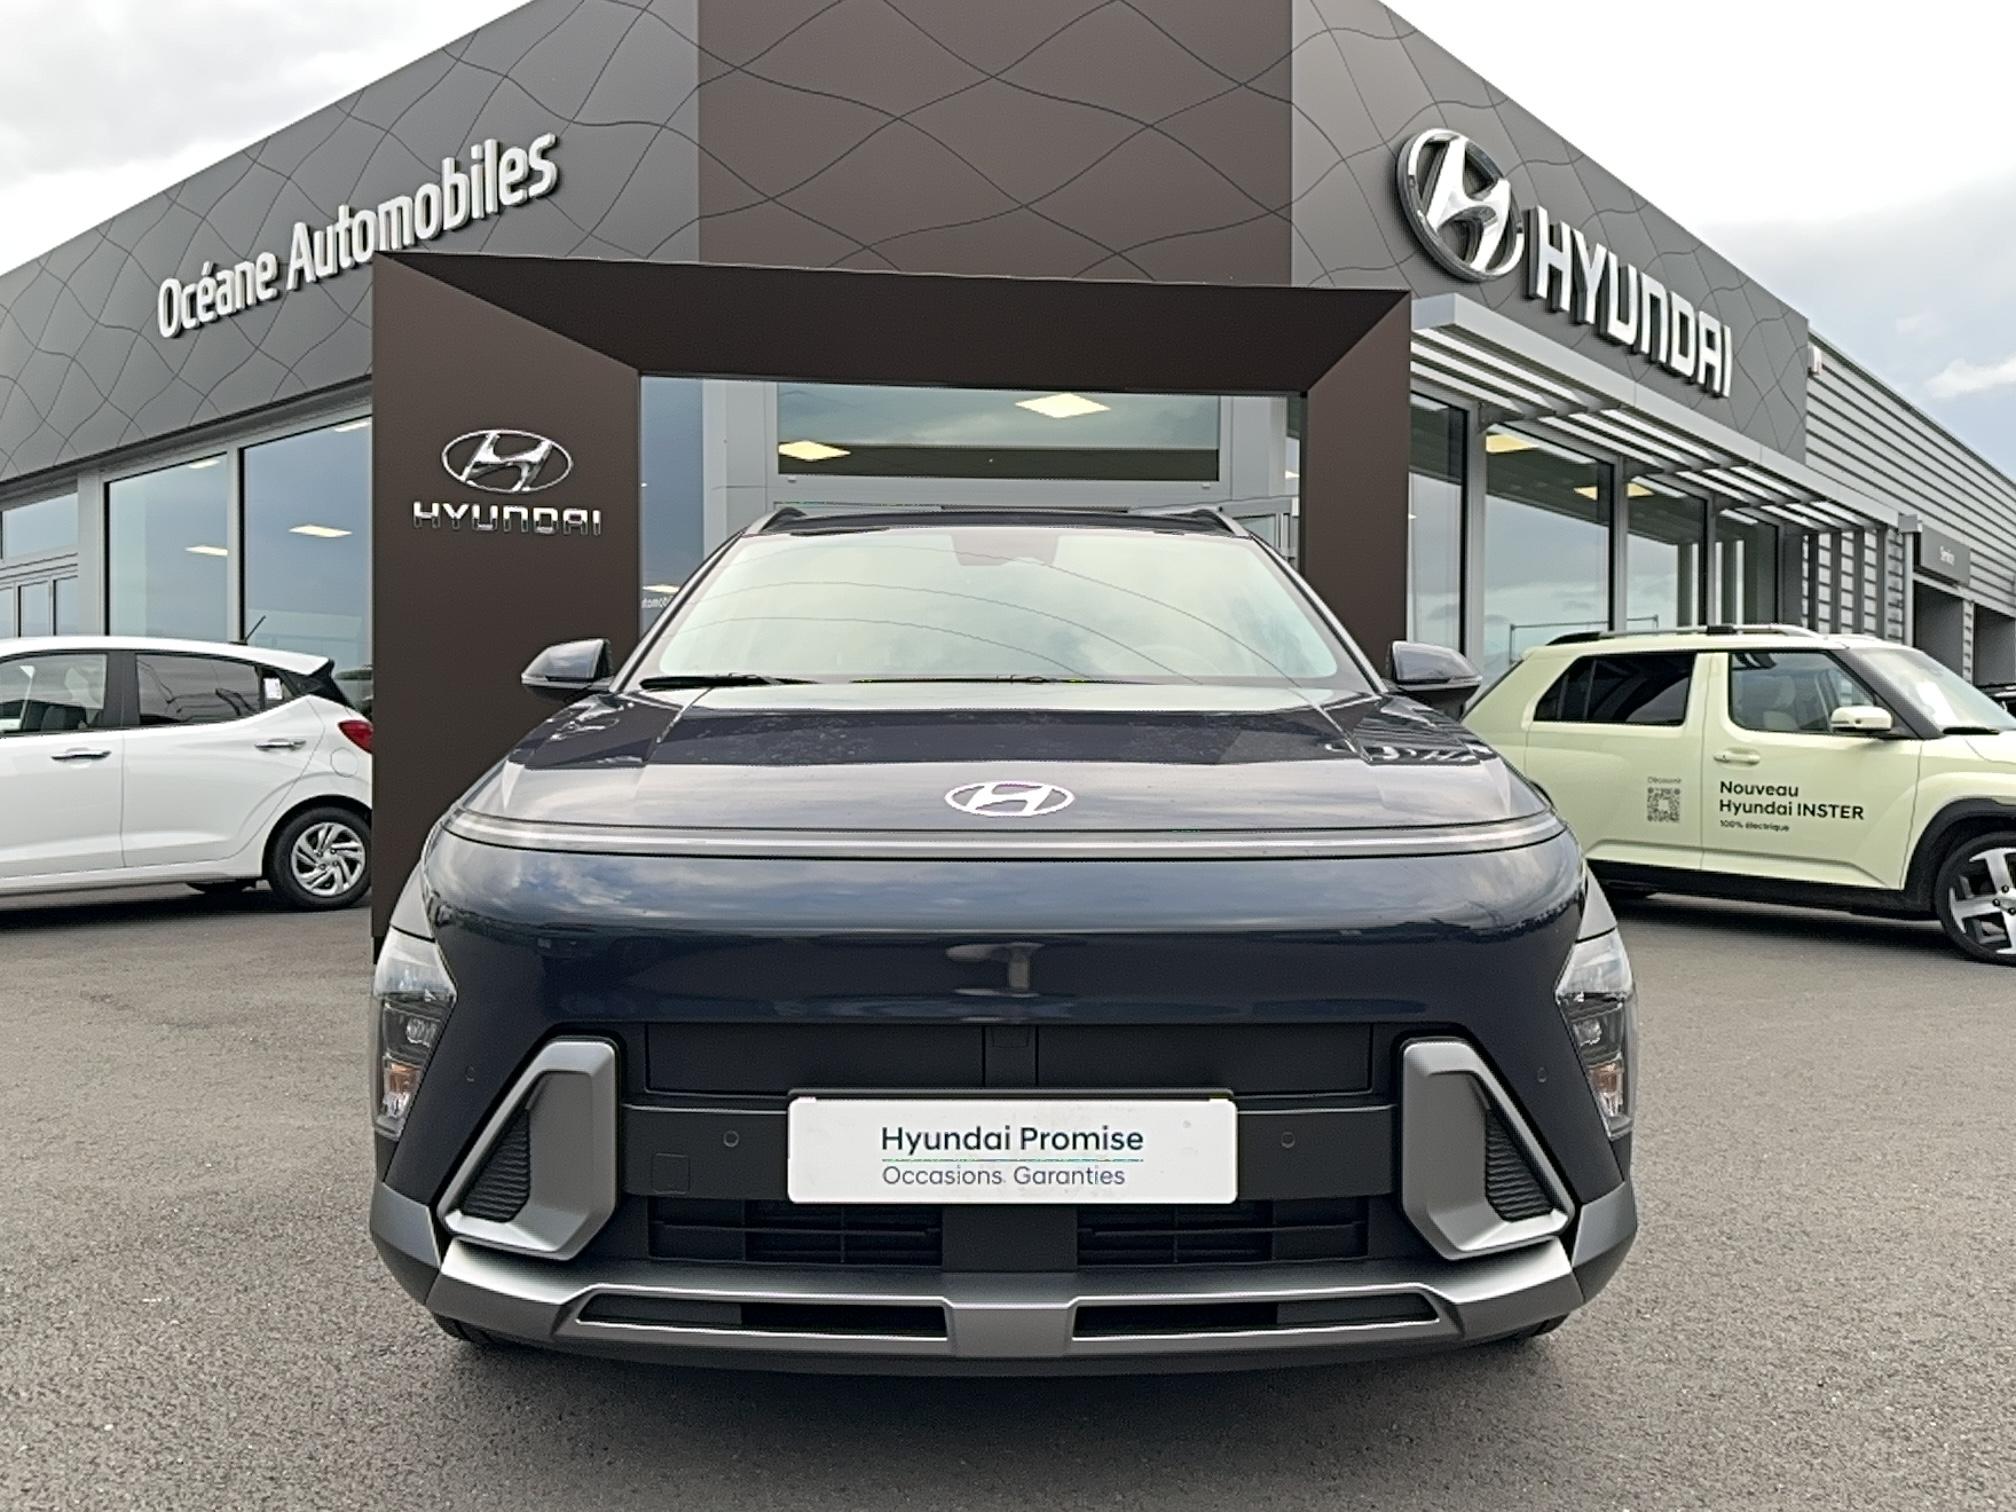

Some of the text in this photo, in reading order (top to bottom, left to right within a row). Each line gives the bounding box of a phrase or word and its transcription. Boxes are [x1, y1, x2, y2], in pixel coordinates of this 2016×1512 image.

[158, 133, 558, 338] Océane Automobiles
[1528, 205, 1732, 397] HYUNDAI
[412, 501, 602, 536] HYUNDAI
[1720, 780, 1799, 797] Nouveau
[1719, 799, 1864, 820] Hyundai INSTER
[882, 1125, 1144, 1155] Hyundai Promise
[1013, 1165, 1125, 1185] Garanties
